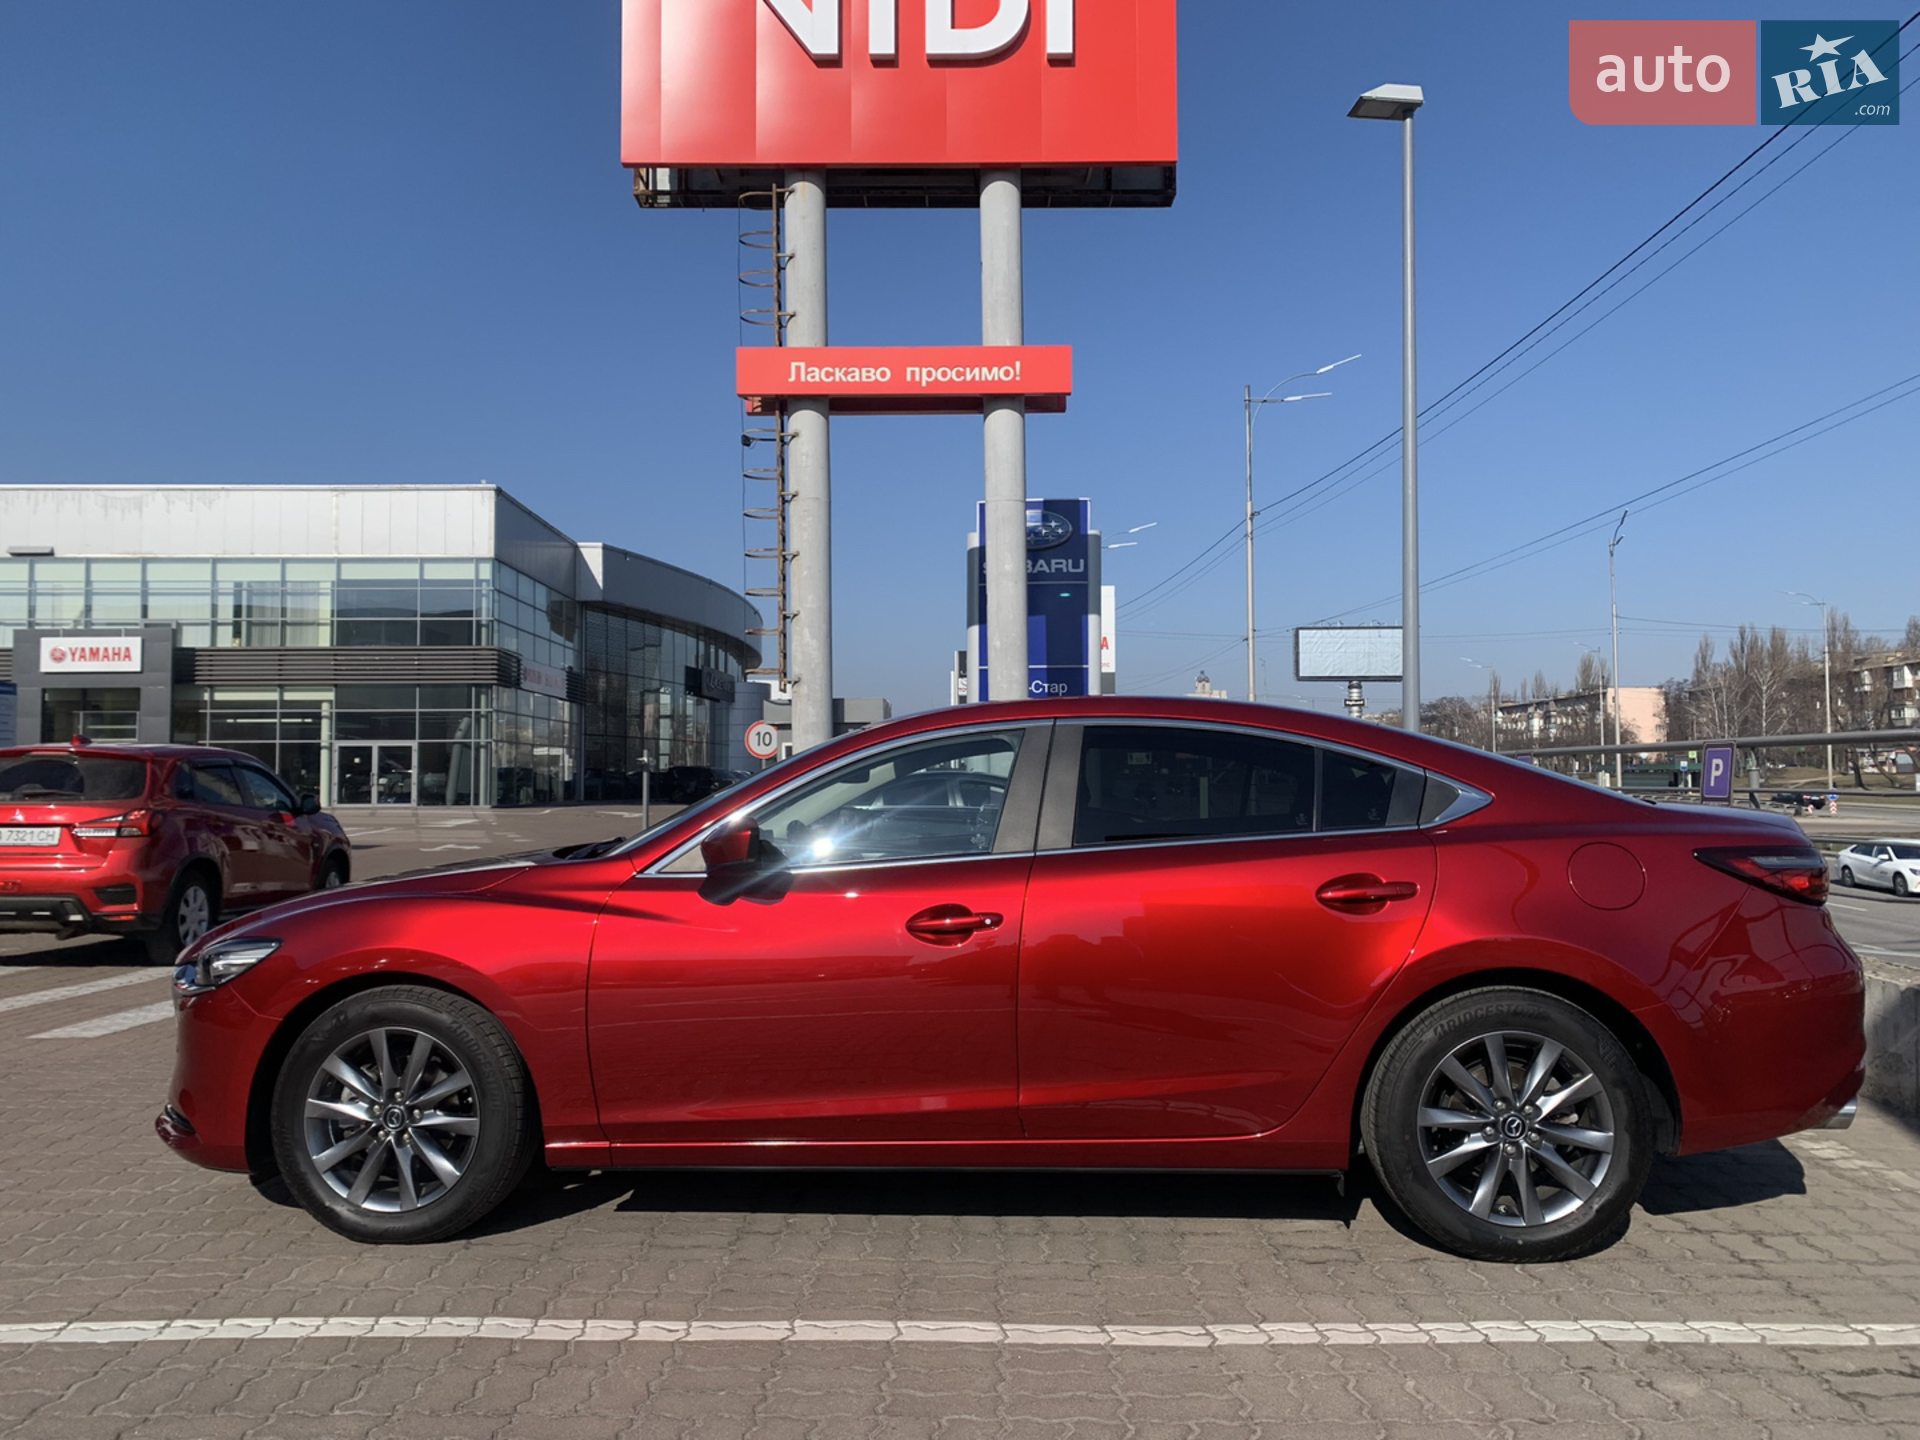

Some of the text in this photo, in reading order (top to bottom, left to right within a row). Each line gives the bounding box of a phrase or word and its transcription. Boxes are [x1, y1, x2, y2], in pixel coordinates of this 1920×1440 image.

[788, 360, 1021, 387] Ласкаво просимо!
[68, 646, 132, 662] YAMAHA
[755, 731, 773, 747] 10
[1709, 758, 1724, 787] P
[6, 829, 56, 842] 7321 CH
